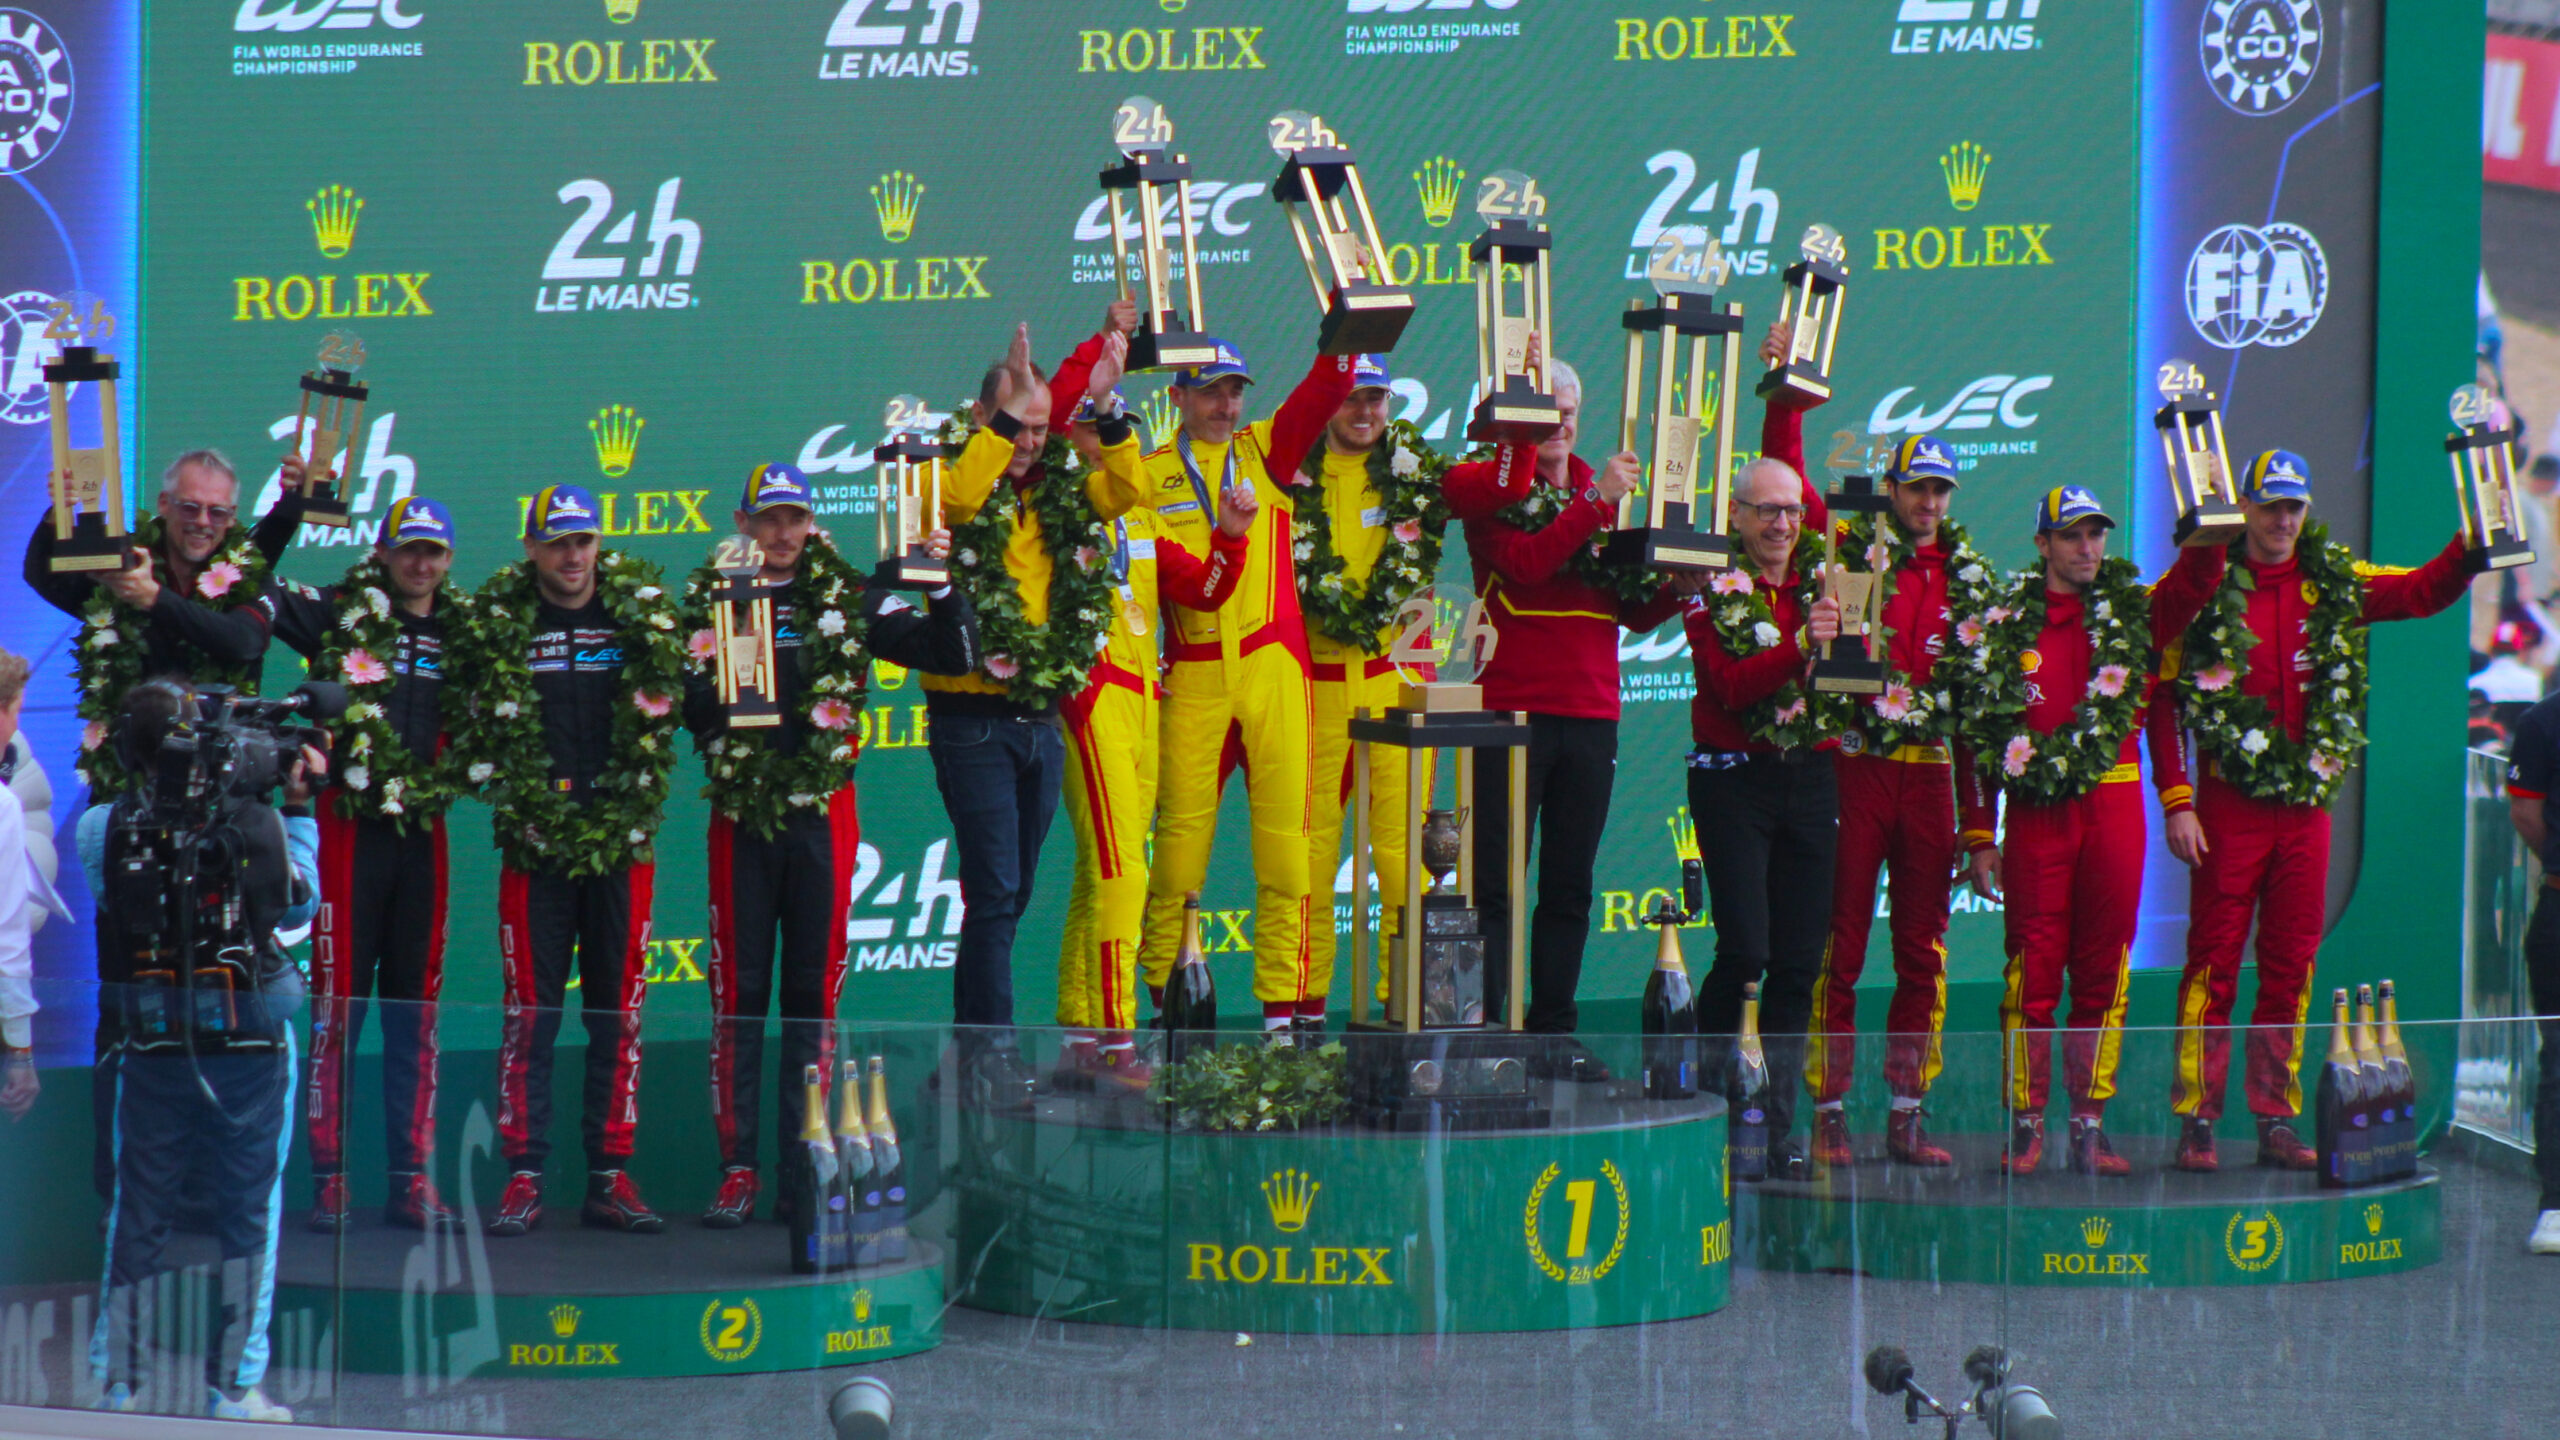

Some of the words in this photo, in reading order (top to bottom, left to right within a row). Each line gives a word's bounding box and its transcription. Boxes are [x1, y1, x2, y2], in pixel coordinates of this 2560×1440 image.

[1346, 25, 1370, 38] FIA
[1374, 24, 1428, 37] WORLD
[1431, 22, 1521, 36] ENDURANCE
[1614, 15, 1797, 61] ROLEX
[1890, 27, 1932, 54] LE
[1937, 25, 2034, 53] MANS
[233, 45, 261, 60] FIA
[265, 44, 322, 58] WORLD
[325, 42, 424, 57] ENDURANCE
[523, 38, 718, 85] ROLEX
[1078, 26, 1267, 72] ROLEX
[1346, 39, 1459, 54] CHAMPIONSHIP
[233, 59, 357, 75] CHAMPIONSHIP
[819, 52, 863, 79] LE
[868, 50, 969, 78] MANS
[1115, 105, 1174, 144] 24h
[1631, 148, 1779, 248] 24h
[542, 176, 702, 281] 24h
[1072, 253, 1095, 268] FIA
[1873, 224, 2054, 270] ROLEX
[801, 256, 991, 304] ROLEX
[233, 272, 433, 321] ROLEX
[536, 285, 583, 312] LE
[587, 282, 691, 311] MANS
[1868, 374, 2054, 435] WEC
[714, 539, 766, 569] 24h
[1387, 598, 1499, 664] 24h
[1629, 672, 1681, 690] WORLD
[1843, 734, 1860, 749] 51
[854, 941, 958, 972] MANS
[1565, 1180, 1596, 1258] 1
[2239, 1220, 2267, 1259] 3
[2340, 1238, 2402, 1264] ROLEX
[1188, 1243, 1392, 1285] ROLEX
[2043, 1252, 2149, 1275] ROLEX
[717, 1307, 748, 1349] 2
[826, 1326, 892, 1354] ROLEX
[509, 1344, 620, 1366] ROLEX
